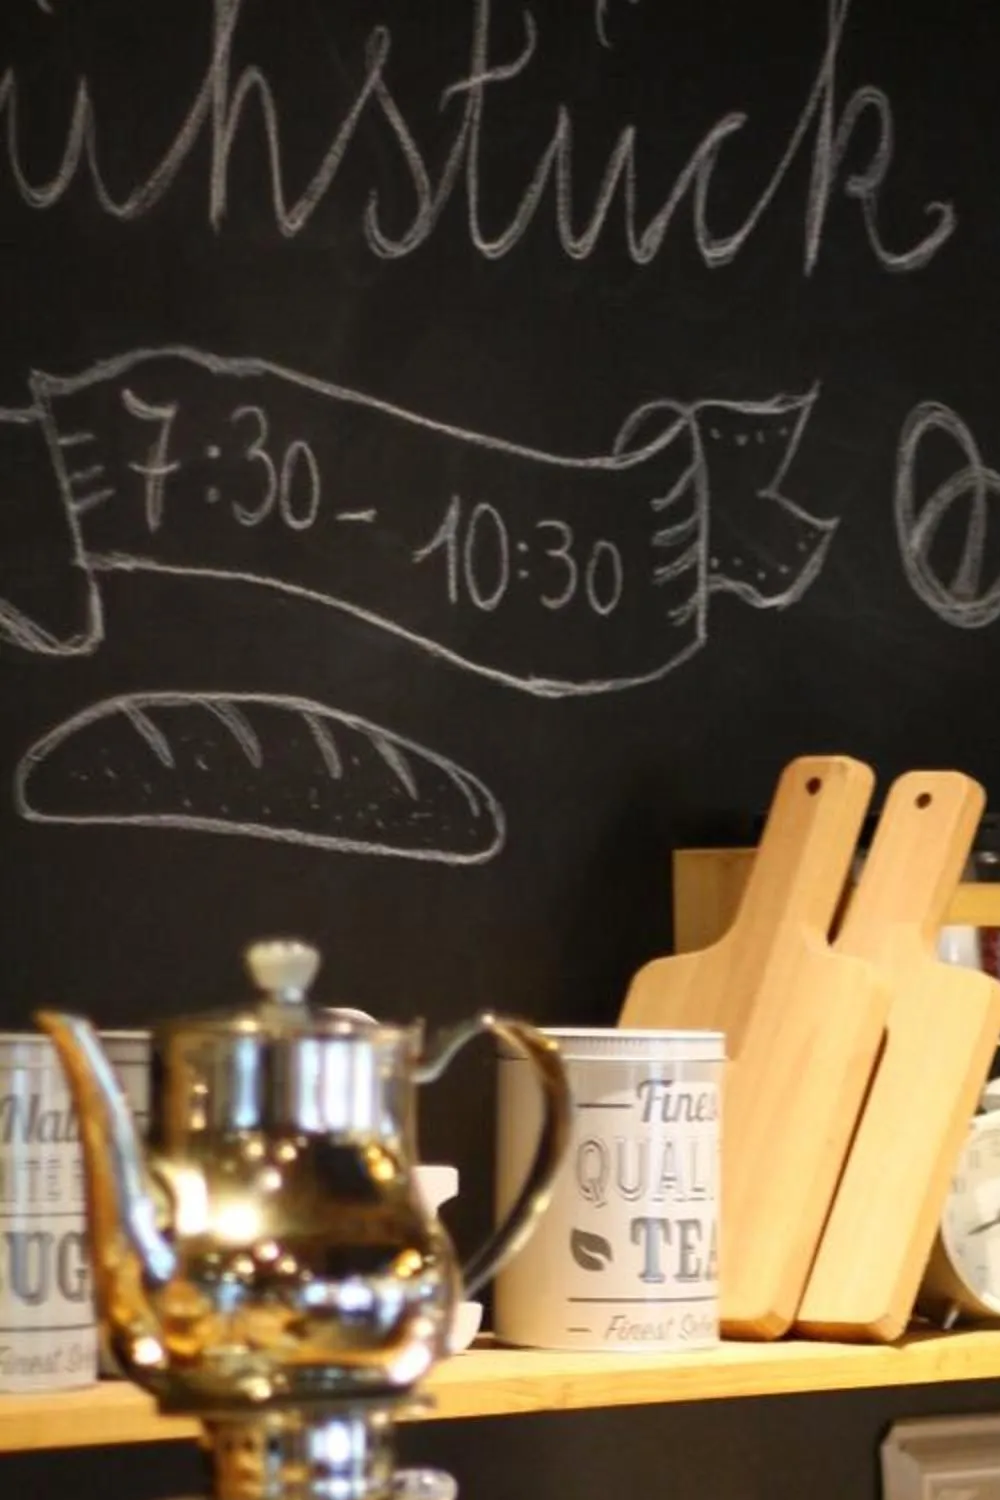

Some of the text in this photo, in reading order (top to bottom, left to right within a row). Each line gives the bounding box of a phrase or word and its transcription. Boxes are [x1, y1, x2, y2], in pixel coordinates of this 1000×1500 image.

[123, 388, 320, 531] 7:30
[412, 494, 623, 615] 10:30
[575, 1135, 717, 1208] QUAL
